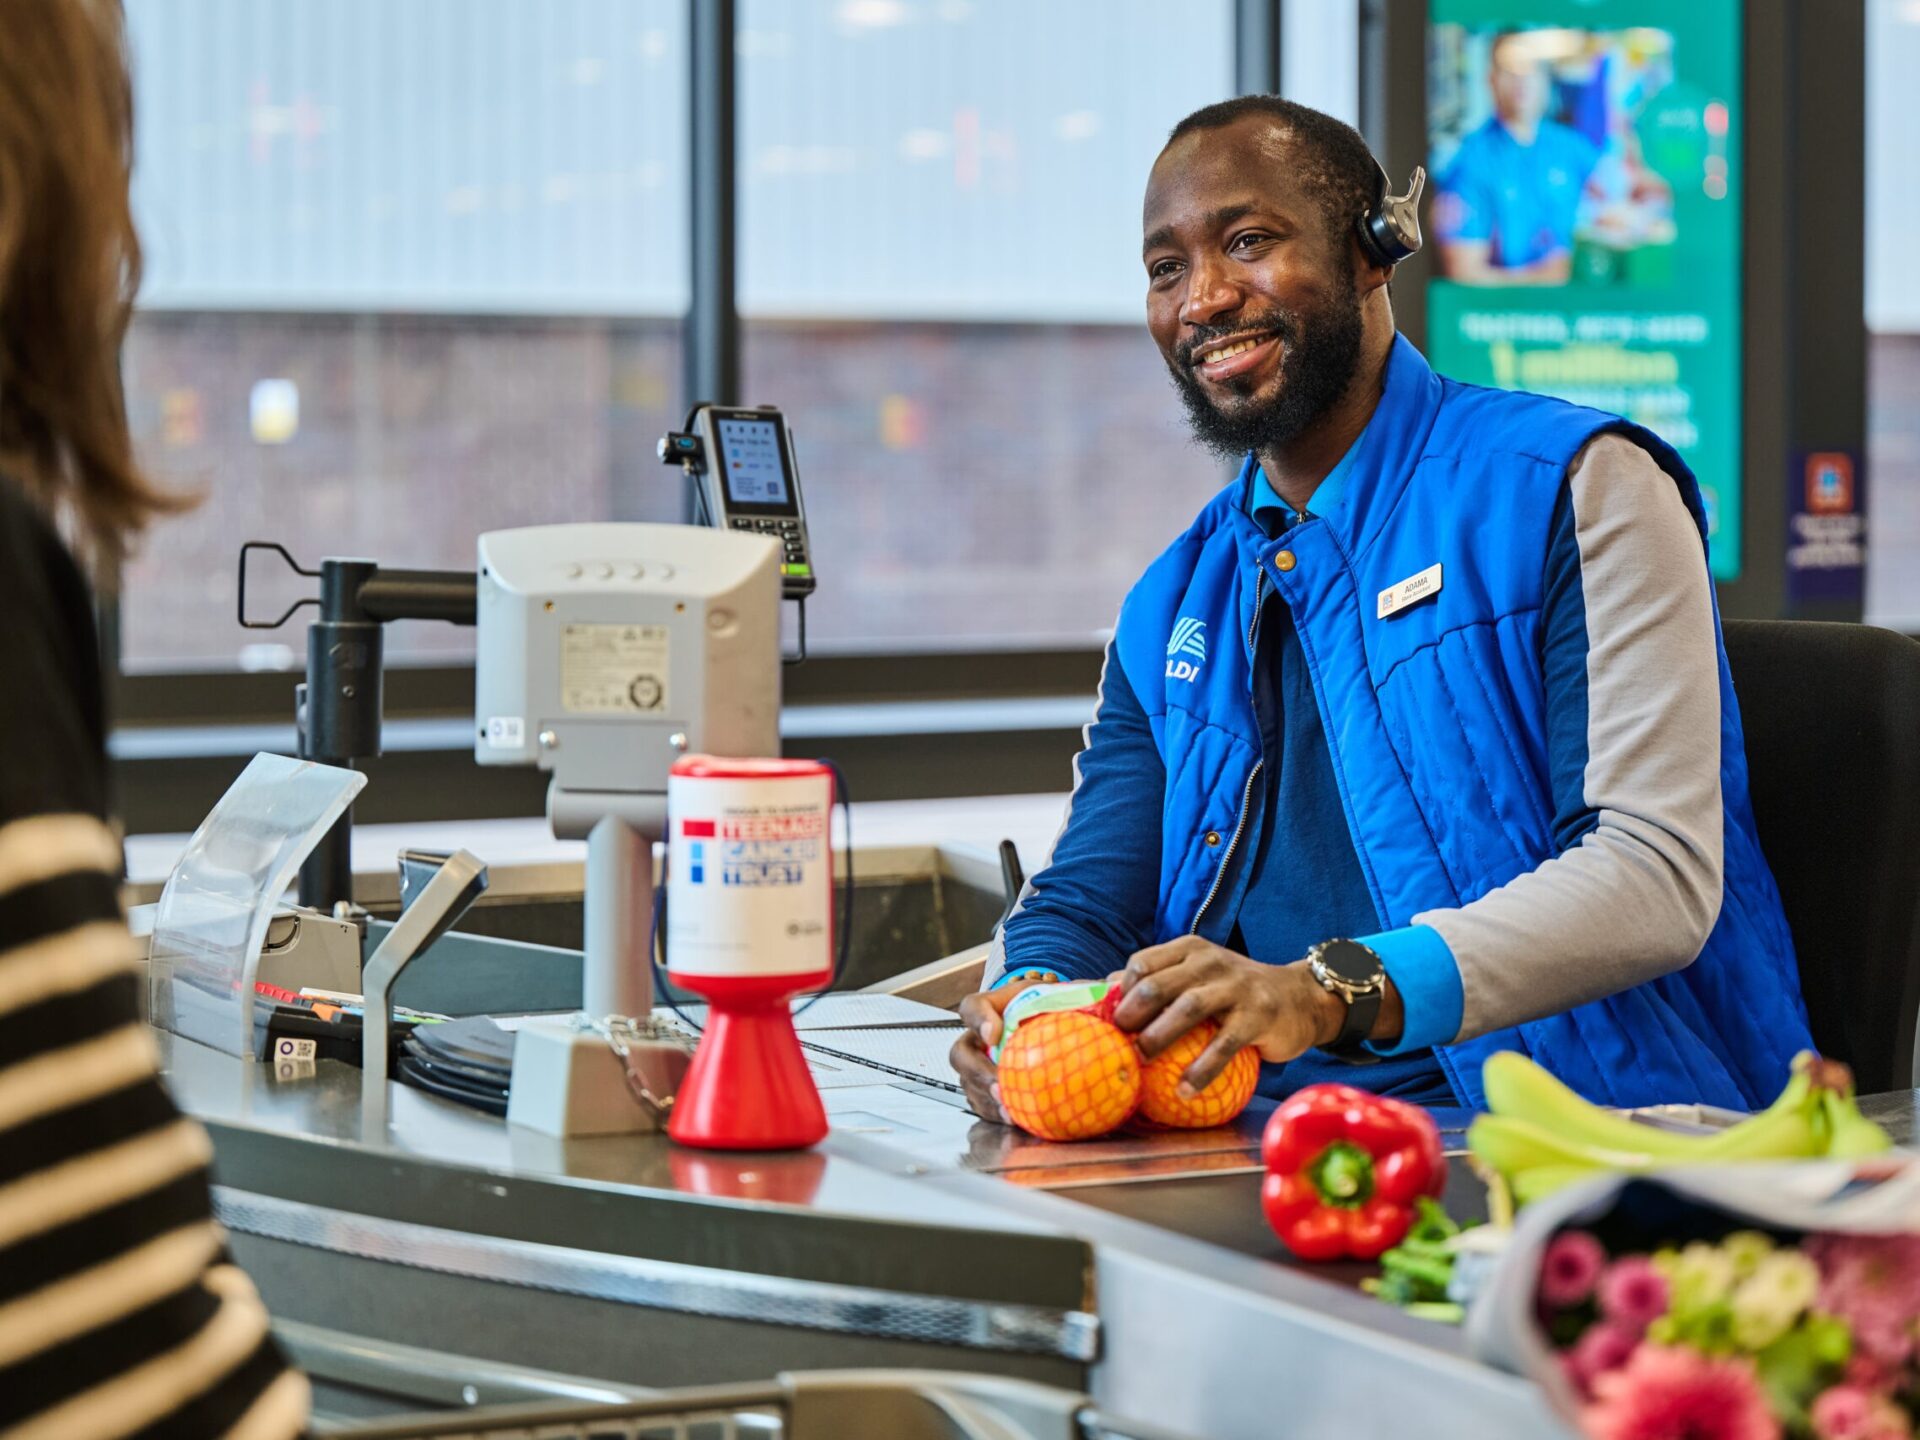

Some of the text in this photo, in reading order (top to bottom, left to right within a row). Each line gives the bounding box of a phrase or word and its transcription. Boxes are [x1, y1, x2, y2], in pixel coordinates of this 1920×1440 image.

[1405, 576, 1428, 593] ADAMA
[1165, 659, 1200, 683] LDI
[722, 862, 803, 886] TRUST
